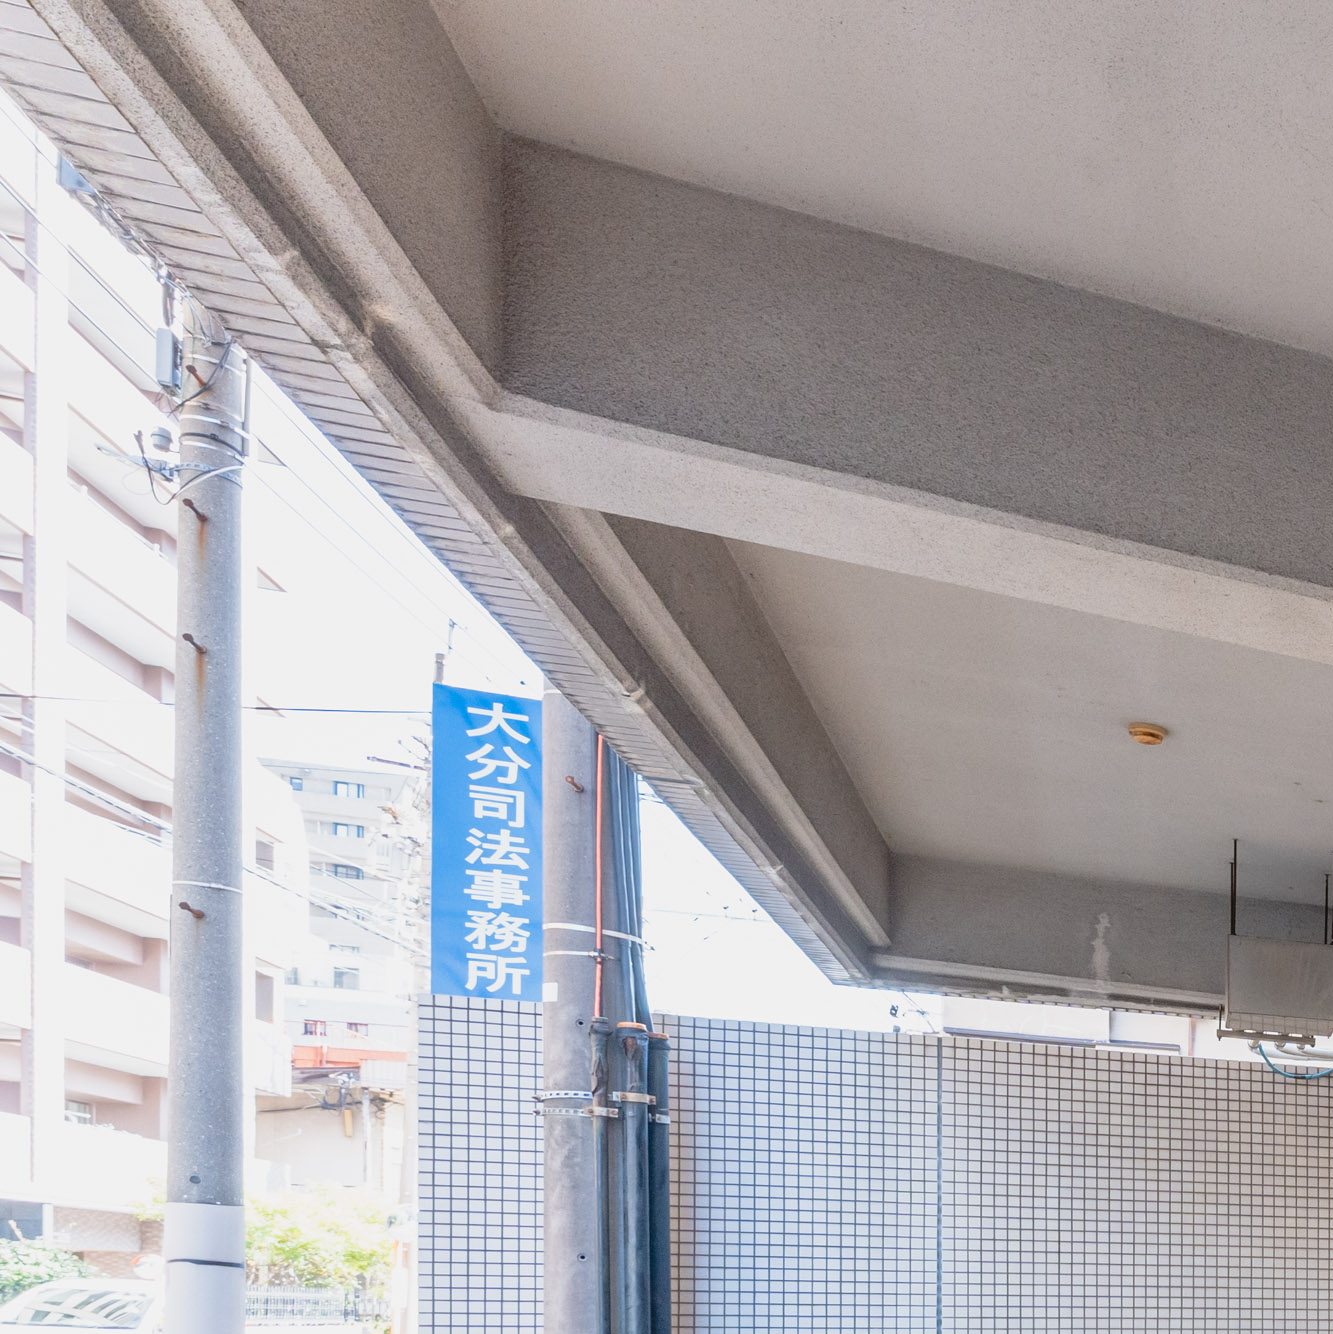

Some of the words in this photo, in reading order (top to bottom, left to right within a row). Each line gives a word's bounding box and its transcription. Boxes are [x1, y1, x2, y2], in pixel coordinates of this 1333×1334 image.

[464, 702, 532, 995] 大分司法事務所
